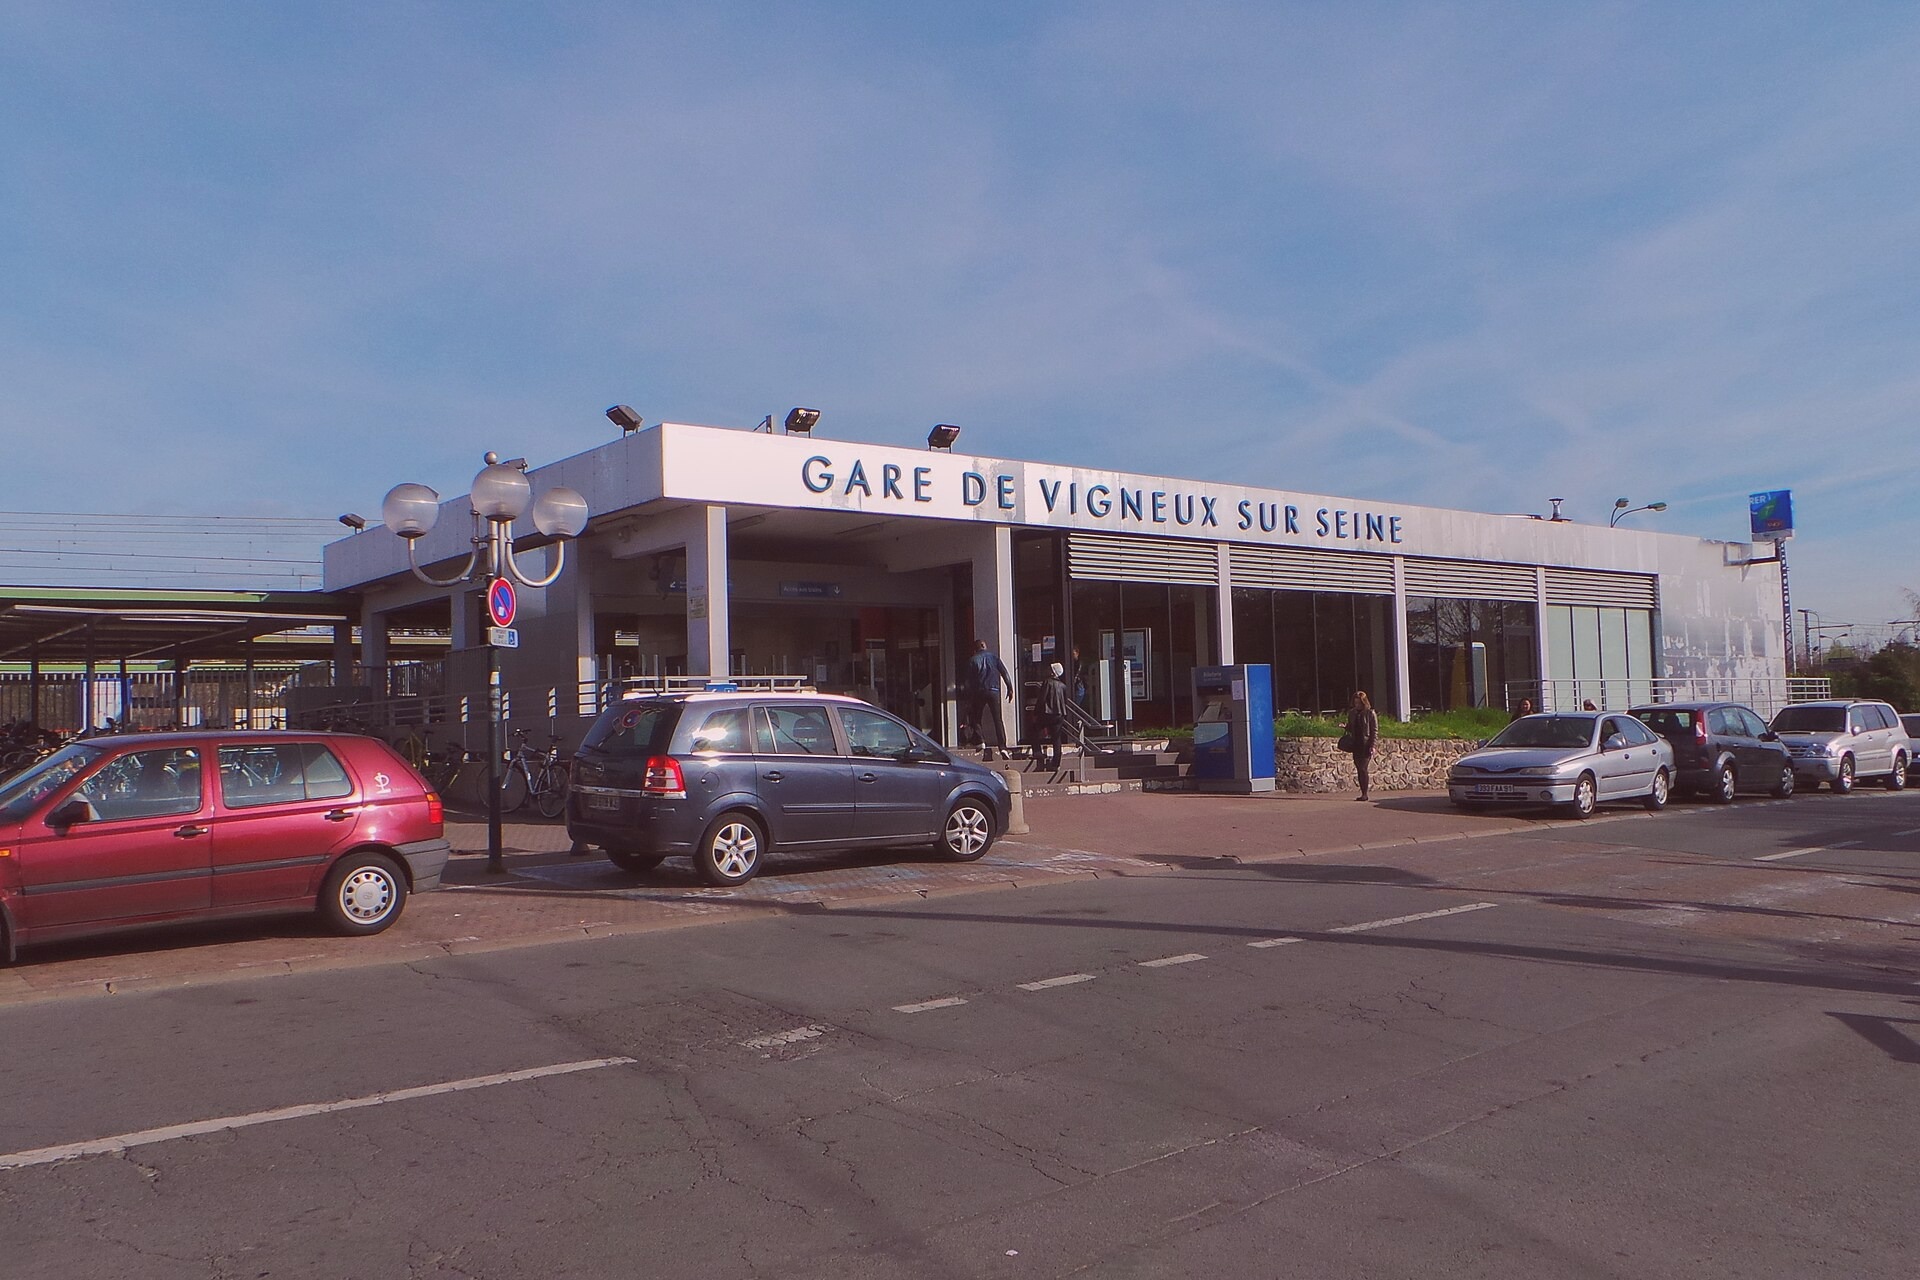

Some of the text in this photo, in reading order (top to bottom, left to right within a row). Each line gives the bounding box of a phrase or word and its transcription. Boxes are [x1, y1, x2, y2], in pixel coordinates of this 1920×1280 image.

[802, 455, 1403, 544] GARE DE VIGNEUX SUR SEINE
[1748, 495, 1767, 504] RER
